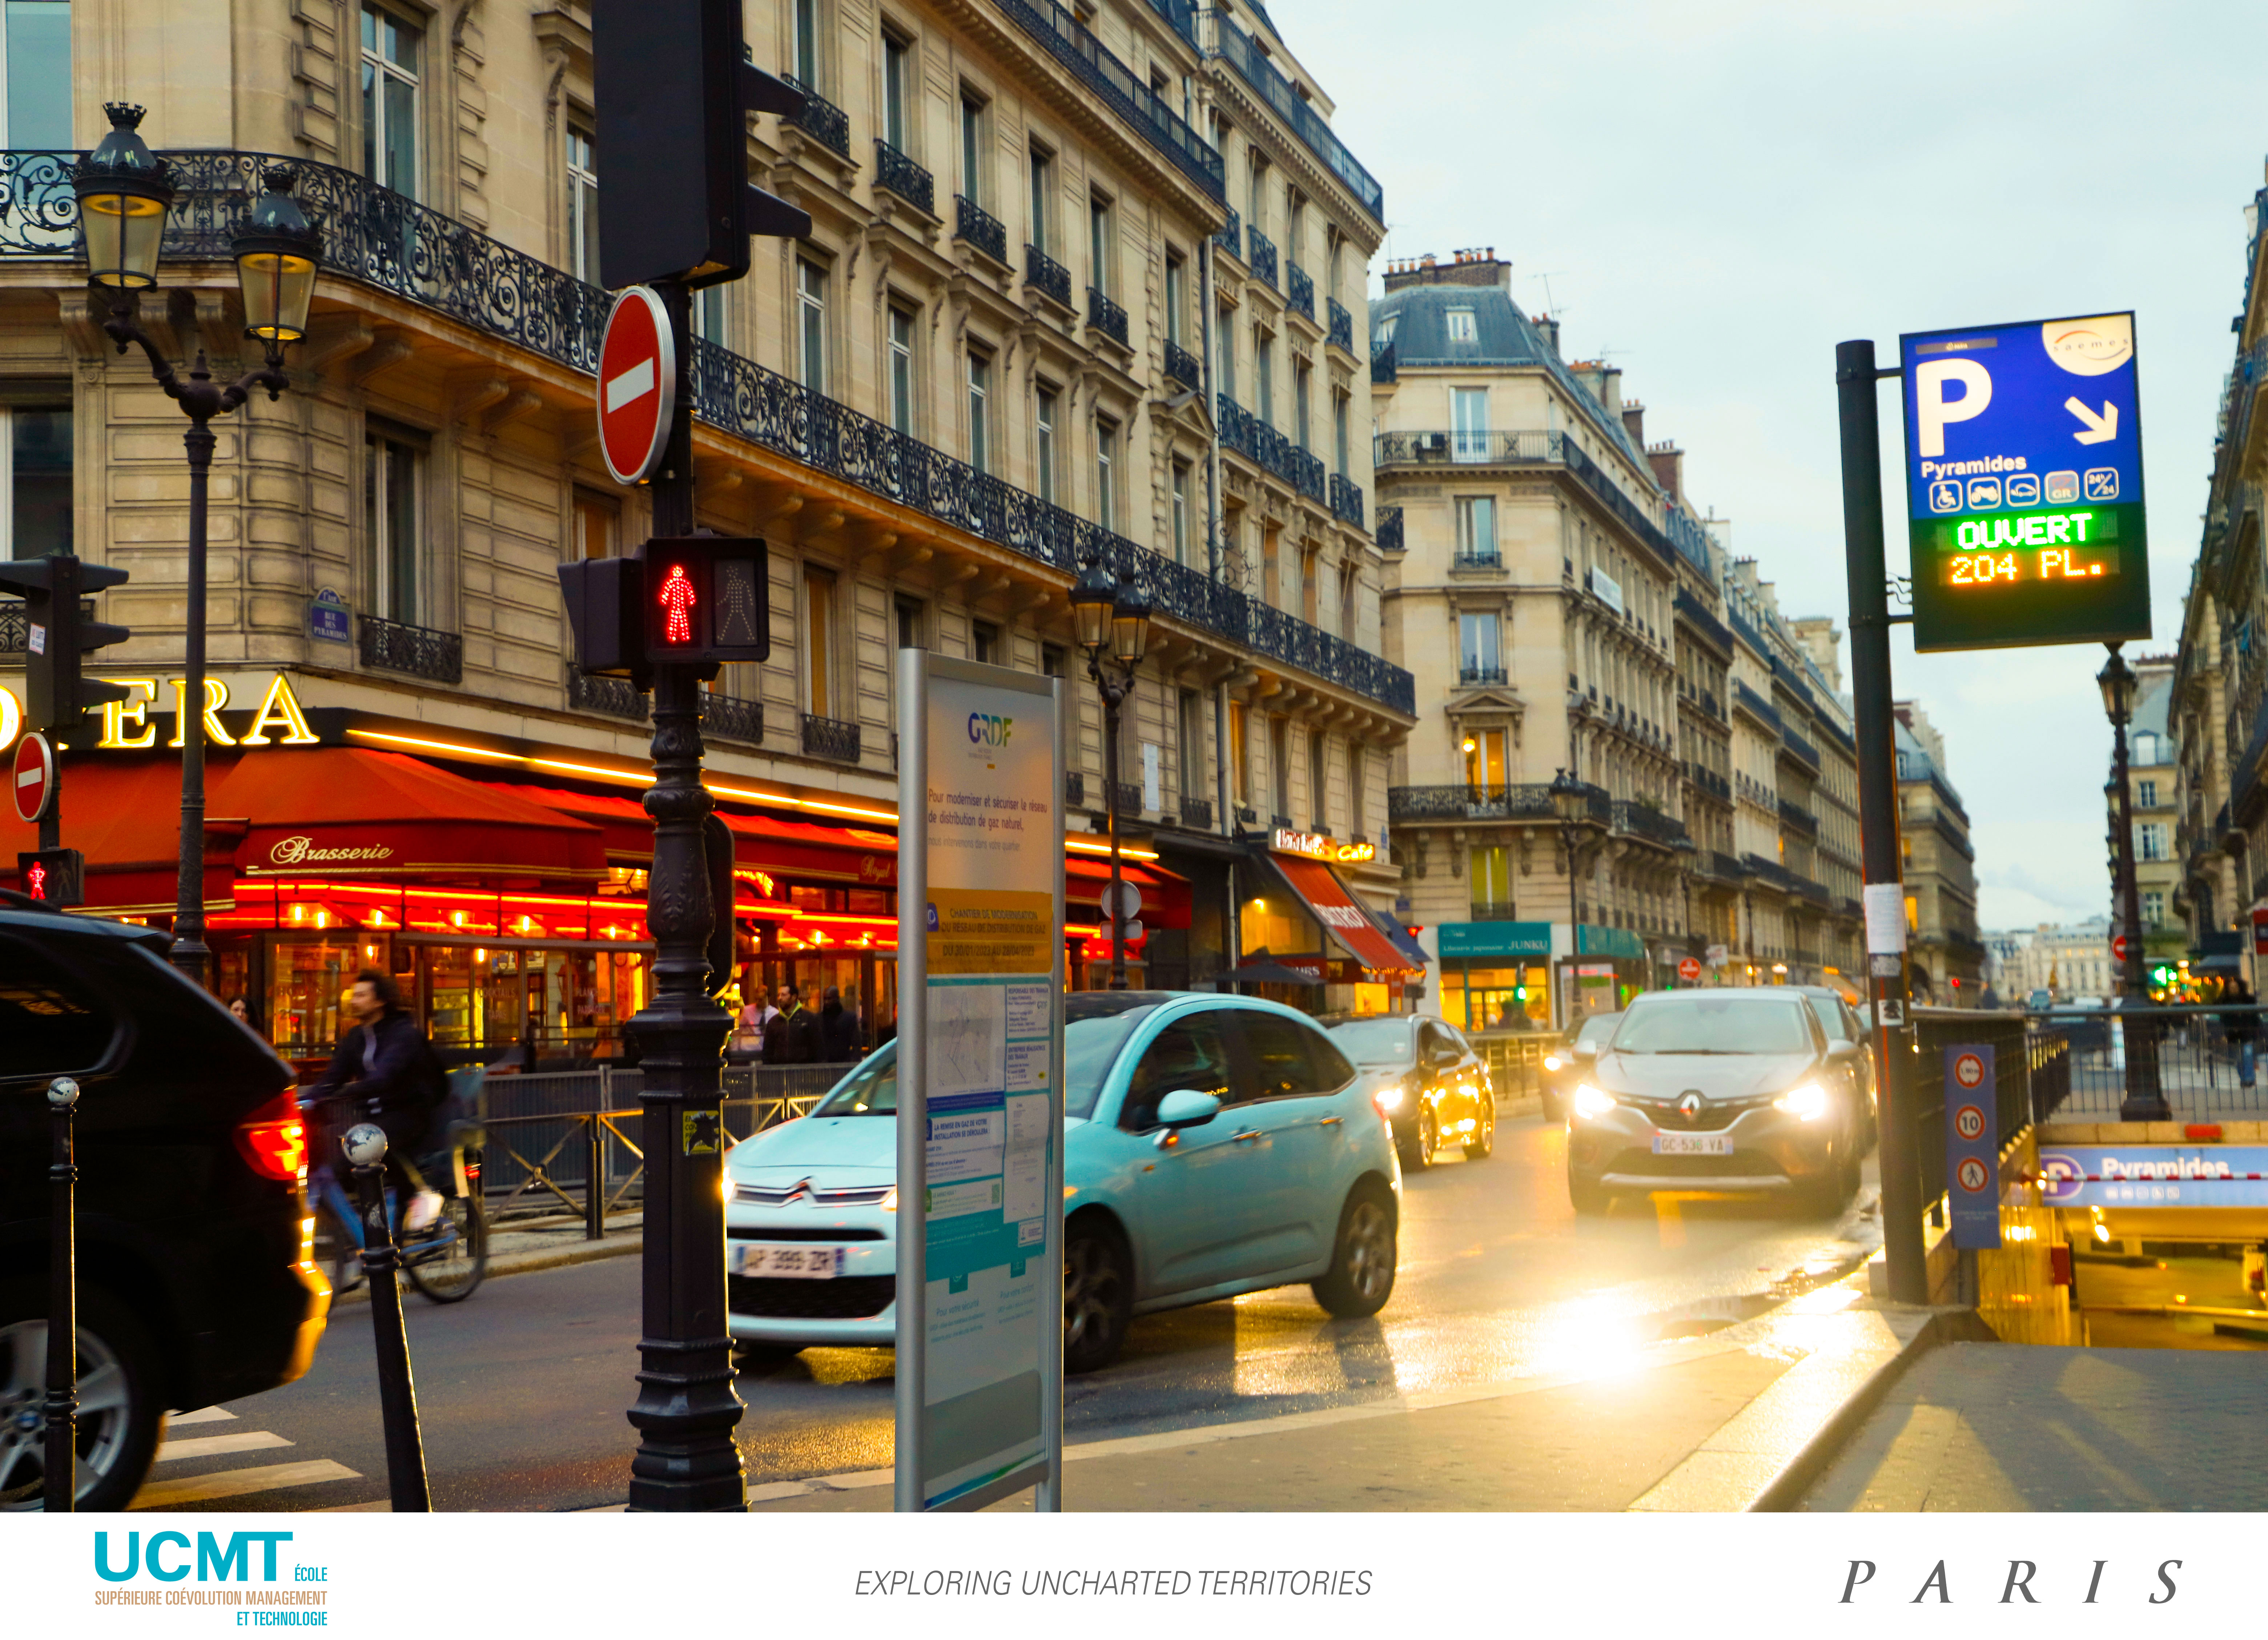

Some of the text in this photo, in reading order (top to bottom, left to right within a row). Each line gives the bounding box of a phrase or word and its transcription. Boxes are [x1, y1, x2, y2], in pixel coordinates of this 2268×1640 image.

[1916, 358, 1992, 457] P
[1921, 456, 2027, 481] Pyramides
[1957, 513, 2093, 550] OUVERT
[1951, 548, 2102, 584] 204 PL.
[325, 611, 336, 621] RUE
[325, 620, 336, 629] DES
[314, 626, 347, 640] PYRAMIDES
[0, 673, 320, 751] ERA
[968, 712, 1012, 747] GRDF
[929, 788, 1047, 813] Pour moderniser et sécuriser le réseau
[929, 810, 937, 823] de
[940, 811, 976, 826] distribution
[978, 814, 986, 827] de
[988, 818, 999, 831] gaz
[271, 835, 394, 863] Brasserie
[928, 837, 942, 846] nous
[944, 837, 974, 848] intervenons
[976, 839, 987, 849] dans
[989, 840, 1001, 850] votre
[950, 908, 1038, 921] CHANTIER DE MODERNISATION
[942, 922, 951, 933] DU
[977, 923, 986, 933] DE
[988, 923, 1025, 934] DISTRIBUTION
[1026, 925, 1033, 934] DE
[1035, 924, 1046, 934] GAZ
[943, 945, 953, 957] DU
[991, 946, 1001, 957] AU
[1508, 940, 1548, 951] JUNKU
[940, 1122, 954, 1130] REMISE
[1962, 1116, 1979, 1130] 10
[934, 1131, 961, 1140] INSTALLATION
[2101, 1157, 2229, 1183] Pyramides
[937, 1308, 947, 1316] Pour
[949, 1305, 961, 1314] votre
